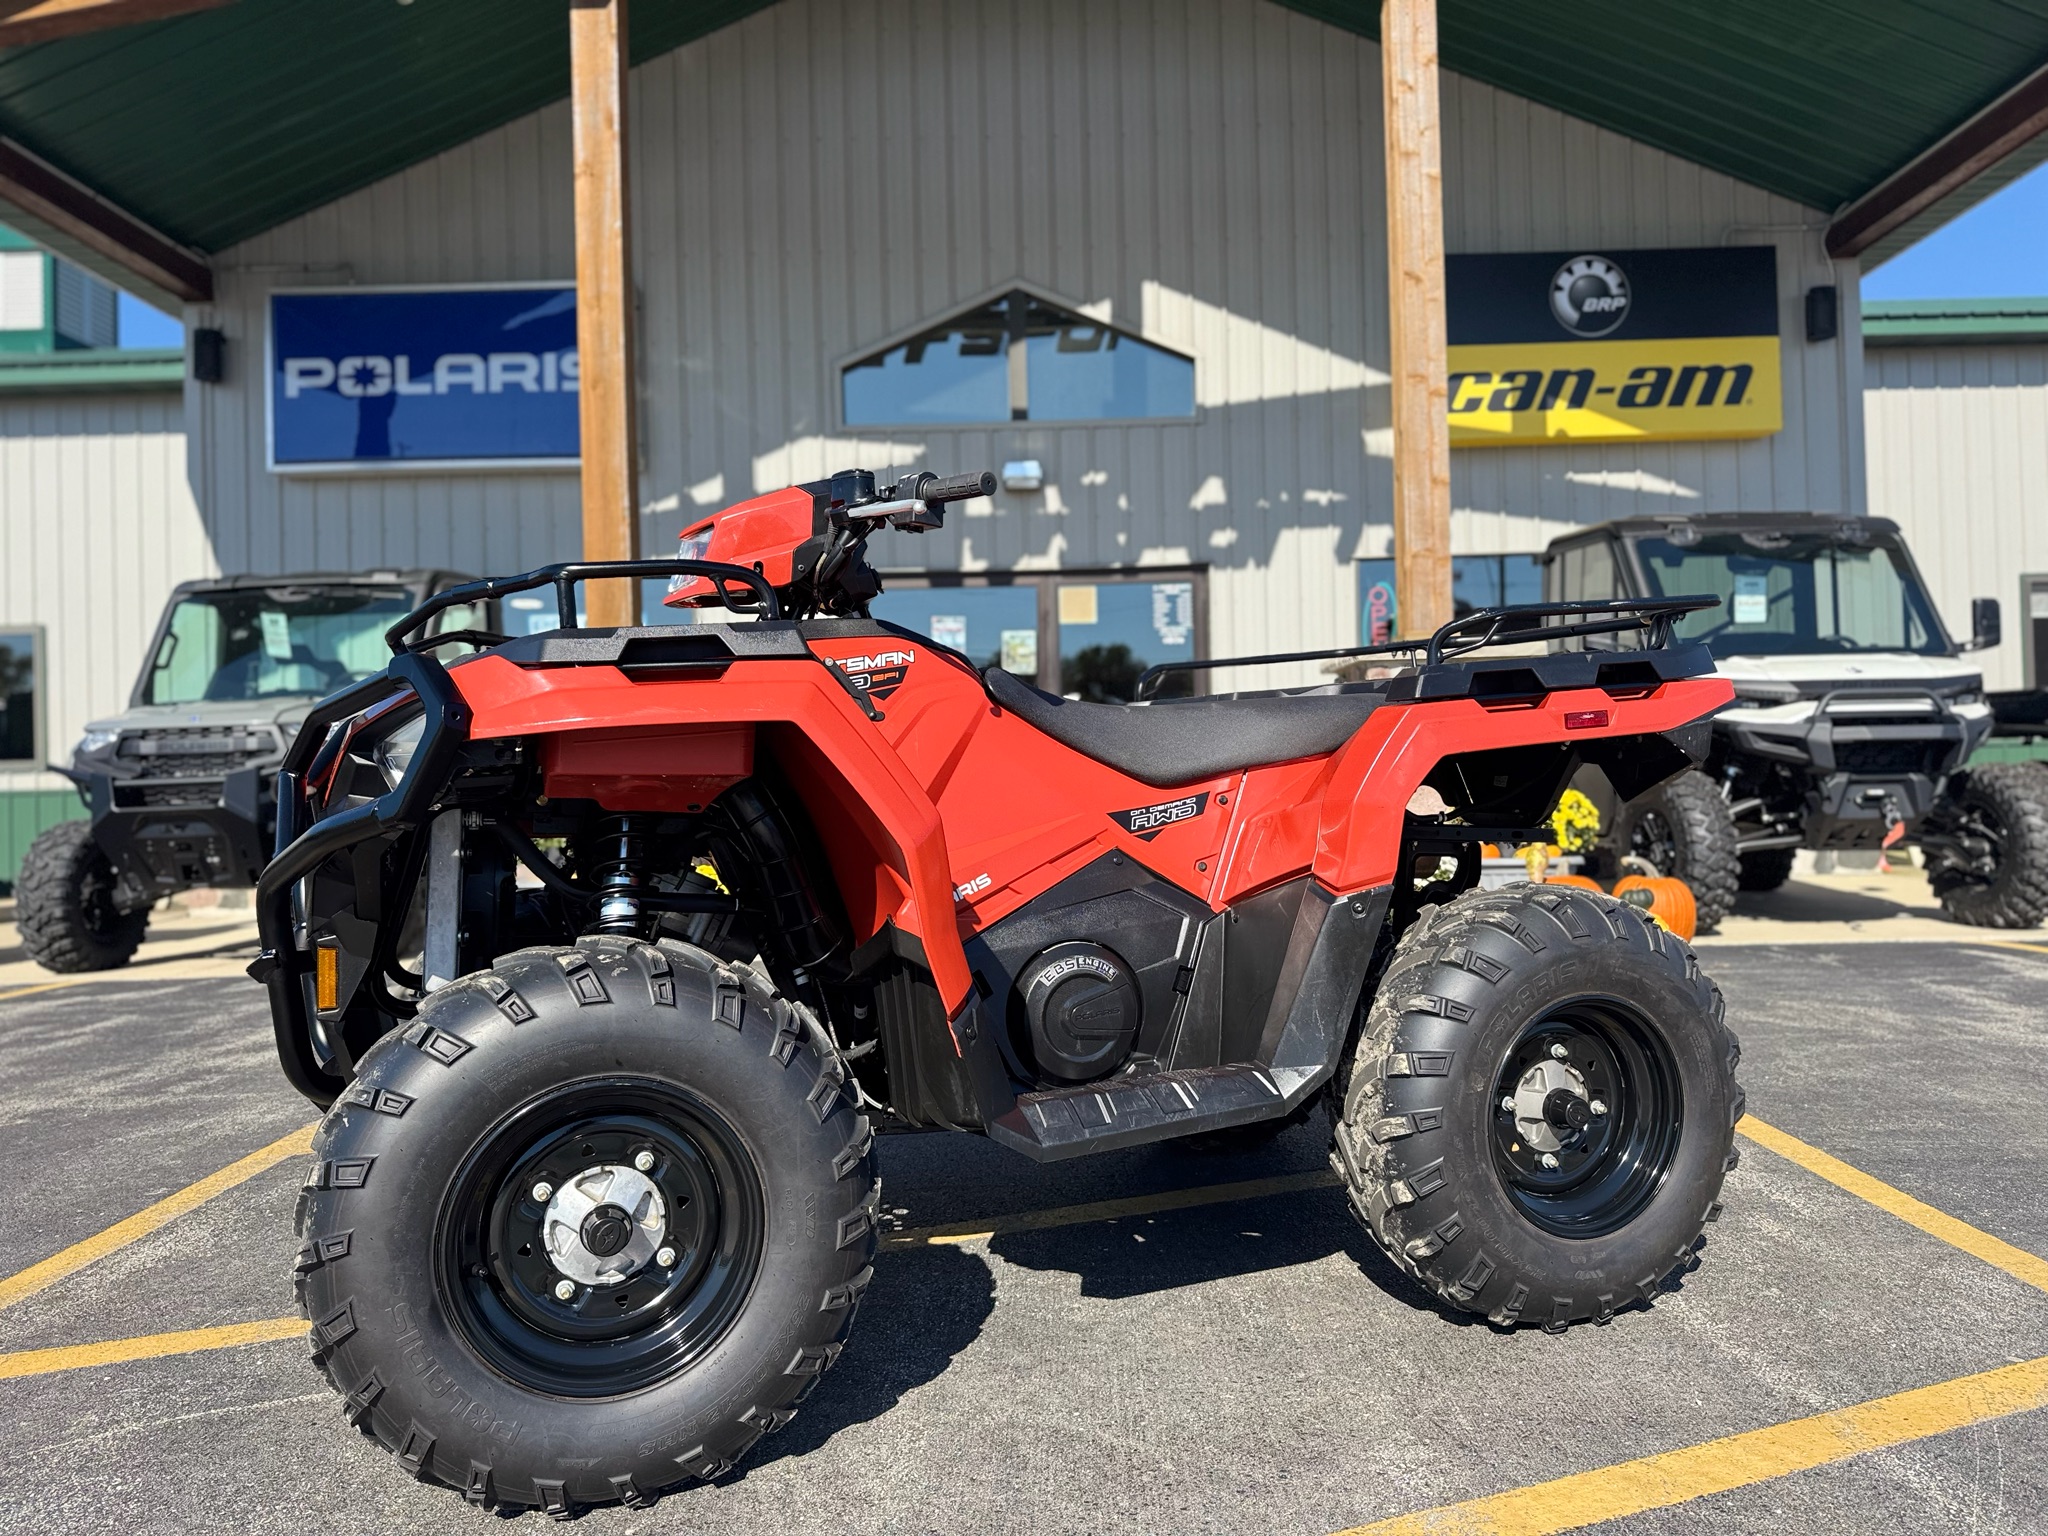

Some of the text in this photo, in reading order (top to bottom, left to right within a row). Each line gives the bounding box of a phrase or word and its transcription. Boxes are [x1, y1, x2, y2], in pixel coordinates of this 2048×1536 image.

[1582, 297, 1627, 313] BRP
[1447, 364, 1753, 413] can-am
[1368, 586, 1389, 646] OPE
[1131, 803, 1197, 830] AWD
[1149, 797, 1197, 812] DEMAND
[1043, 959, 1075, 983] EBS
[1078, 957, 1117, 977] ENGINE
[1478, 959, 1577, 1056] POLARIS
[385, 1302, 523, 1446] POLARIS
